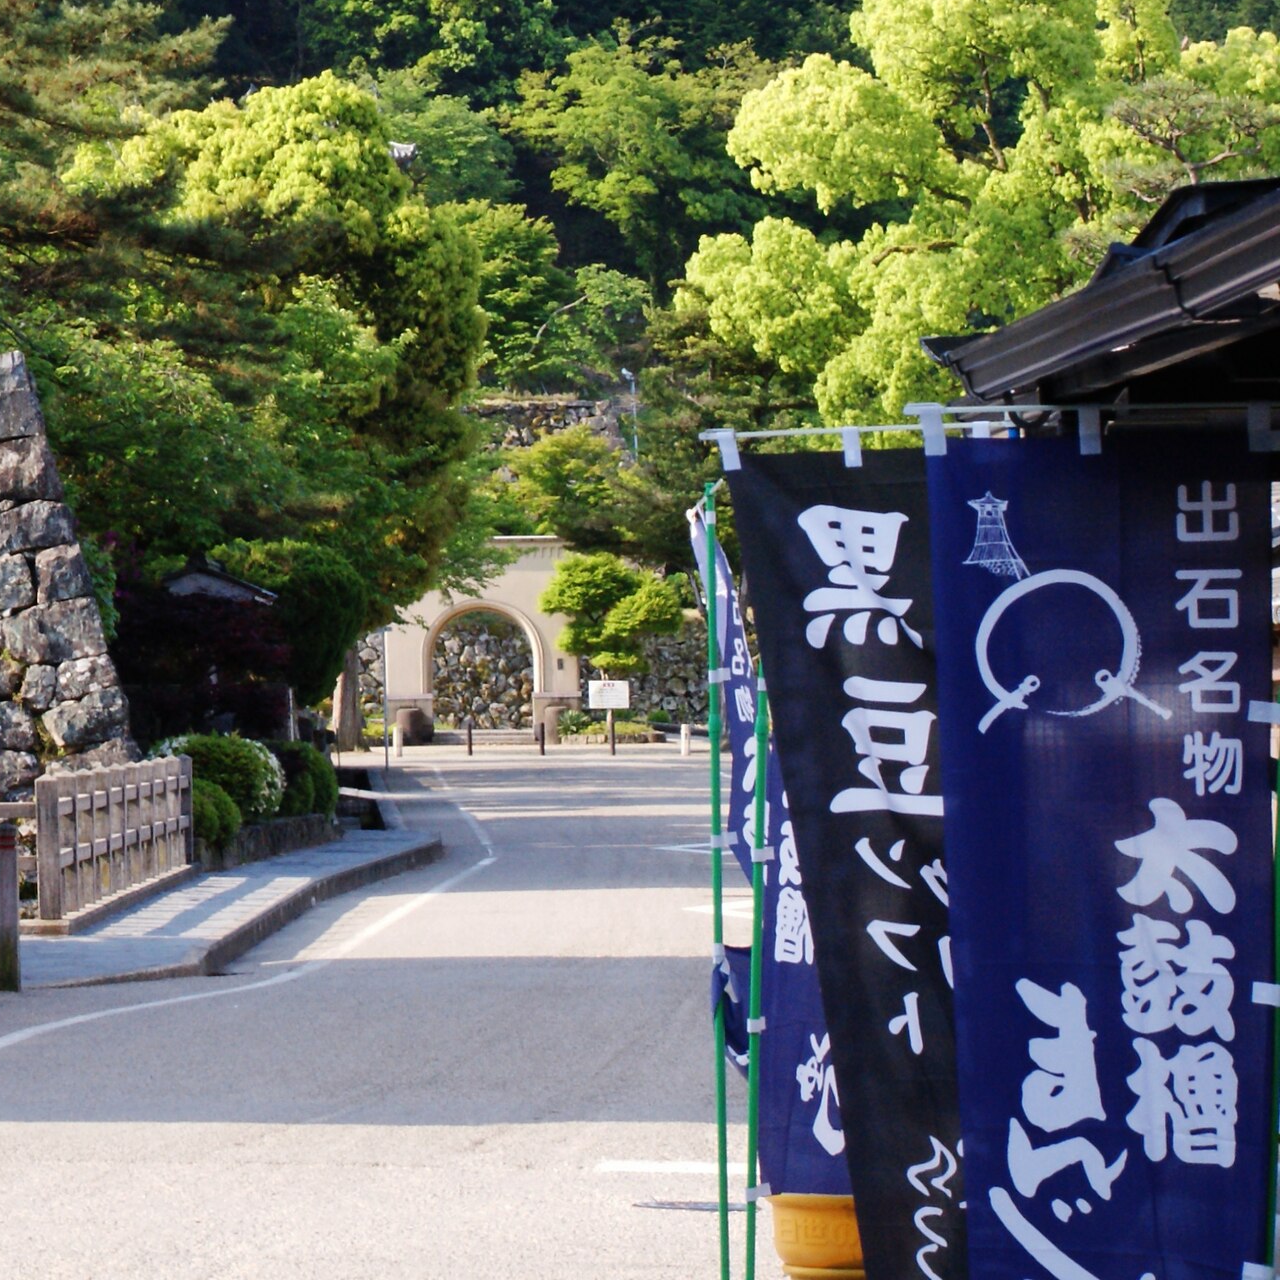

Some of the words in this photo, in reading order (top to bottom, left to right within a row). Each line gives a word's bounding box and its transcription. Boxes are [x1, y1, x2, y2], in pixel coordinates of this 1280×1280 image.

[1174, 480, 1243, 797] 出石名物
[1114, 798, 1238, 1168] 太鼓櫓
